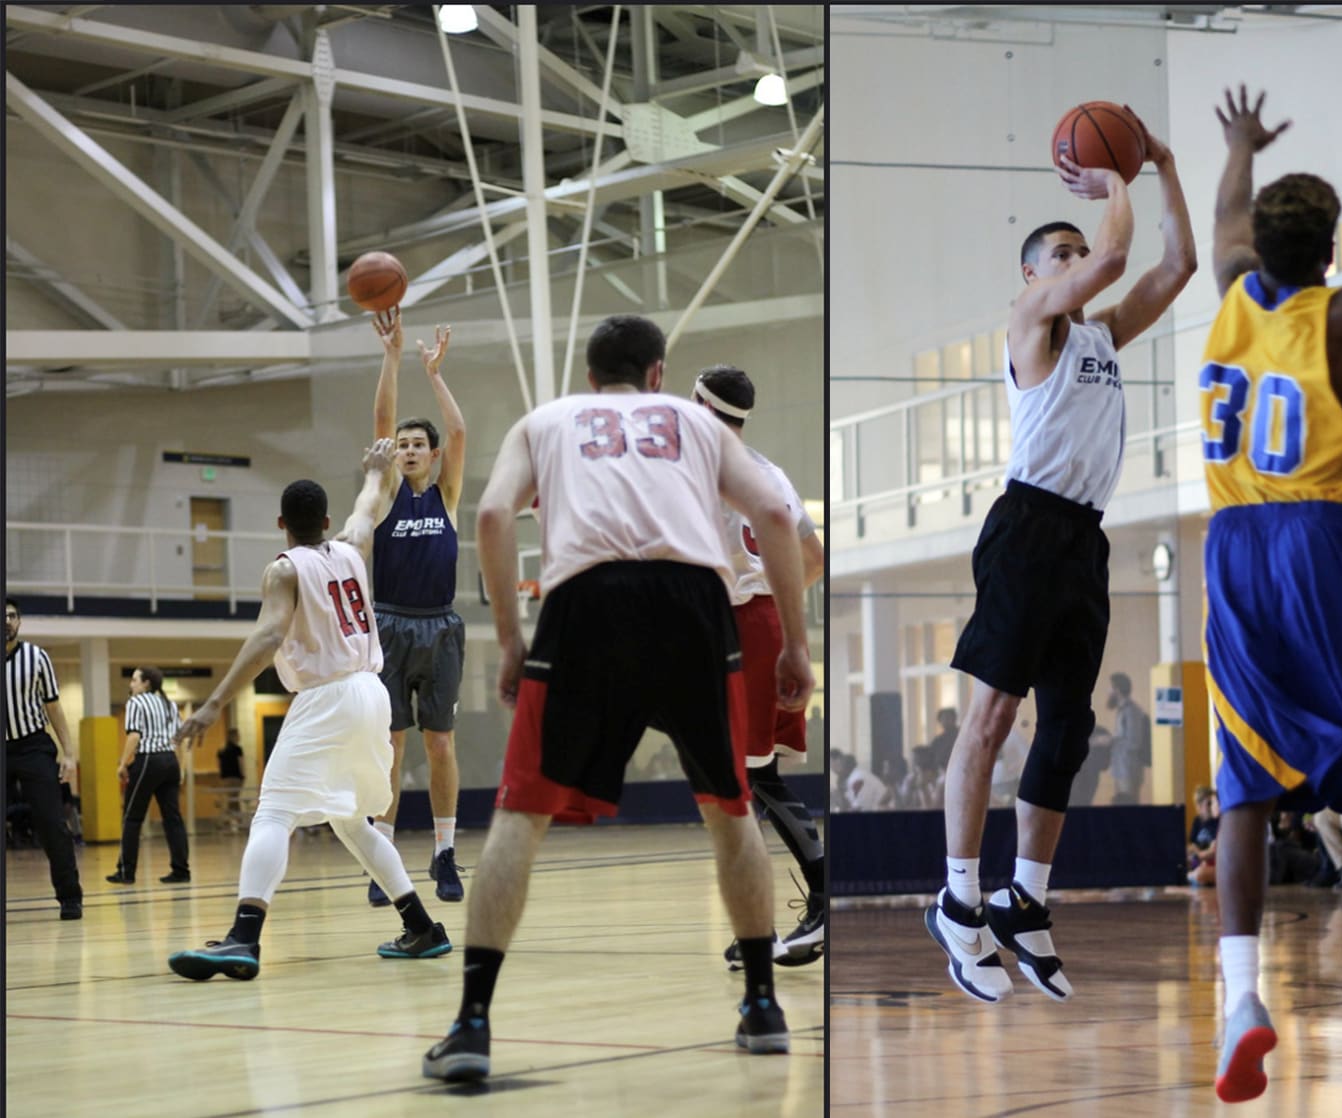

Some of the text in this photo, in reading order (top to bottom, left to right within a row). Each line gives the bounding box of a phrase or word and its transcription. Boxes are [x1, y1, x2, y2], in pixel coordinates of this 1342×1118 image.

[574, 404, 681, 462] 33
[1199, 362, 1306, 476] 30
[394, 517, 446, 531] EMORY
